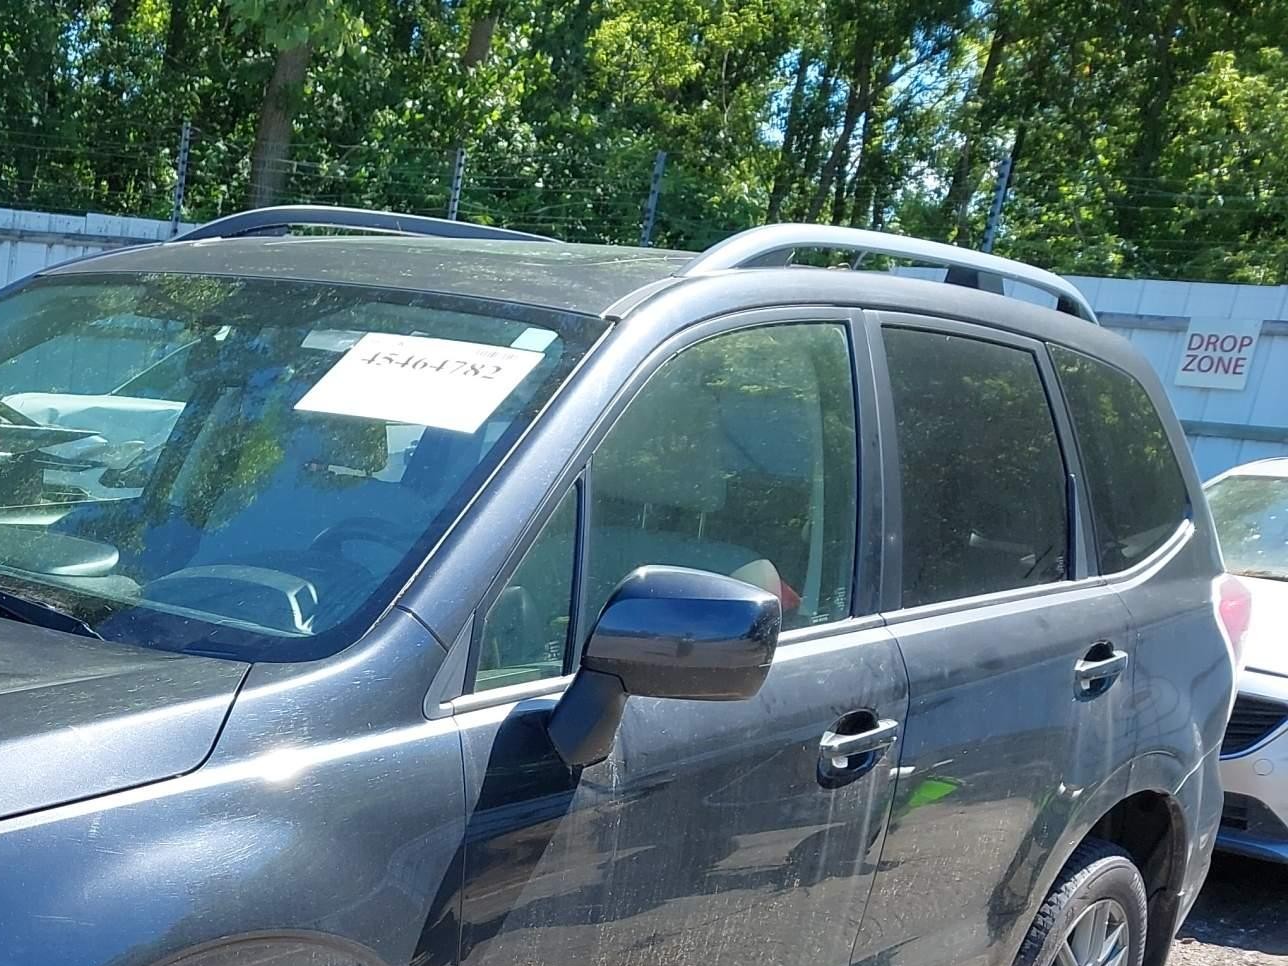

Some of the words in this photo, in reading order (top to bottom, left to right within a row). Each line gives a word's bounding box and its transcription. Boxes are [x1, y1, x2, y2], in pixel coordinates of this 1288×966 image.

[1187, 333, 1253, 353] DROP
[361, 350, 502, 380] 45464782
[1181, 354, 1247, 375] ZONE
